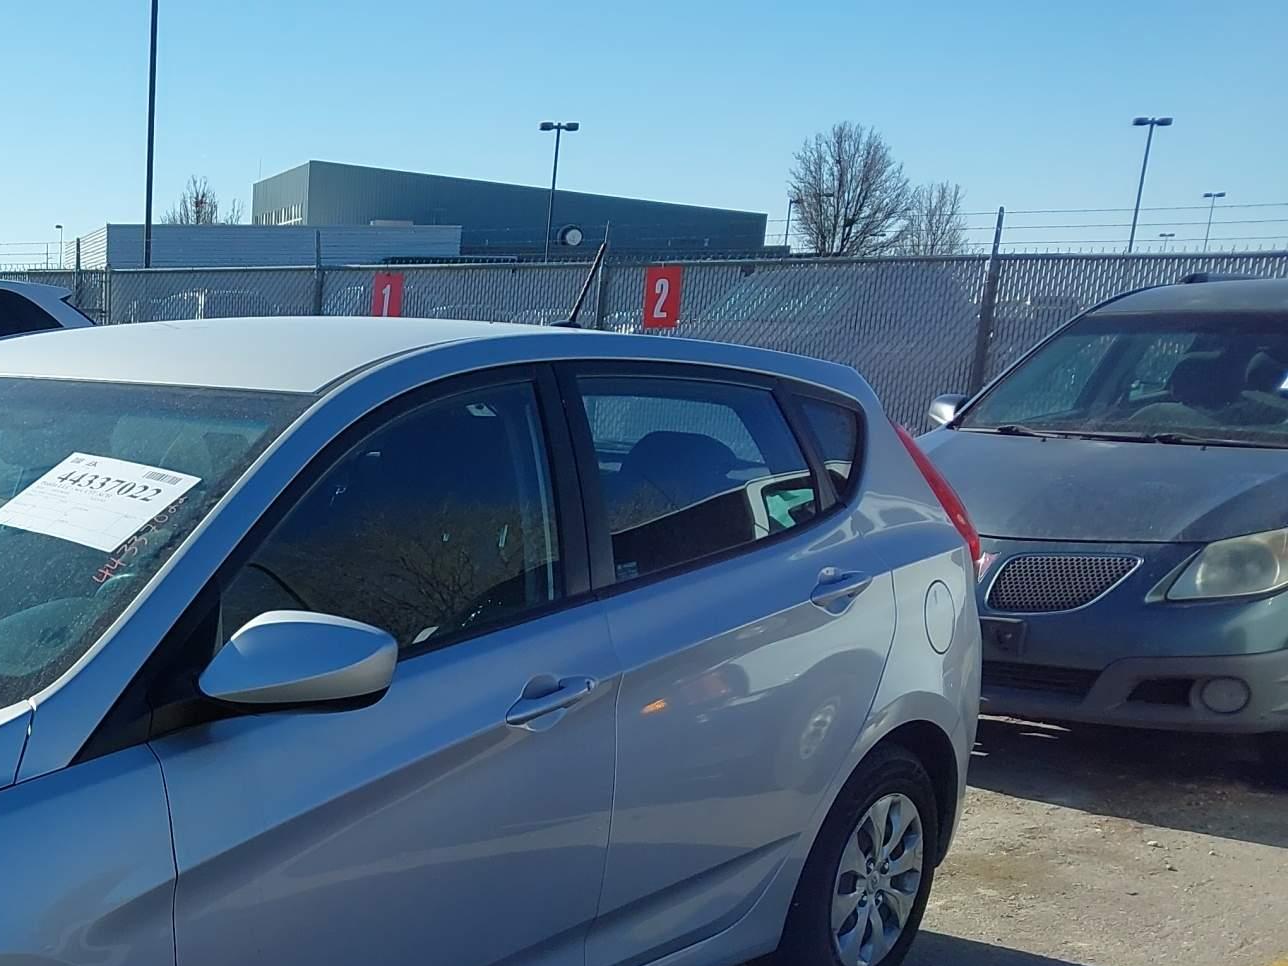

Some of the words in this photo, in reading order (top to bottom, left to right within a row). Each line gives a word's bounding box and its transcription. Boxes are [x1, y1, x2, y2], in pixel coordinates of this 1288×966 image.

[381, 284, 391, 317] 1
[654, 278, 670, 319] 2
[57, 470, 163, 502] 44337022
